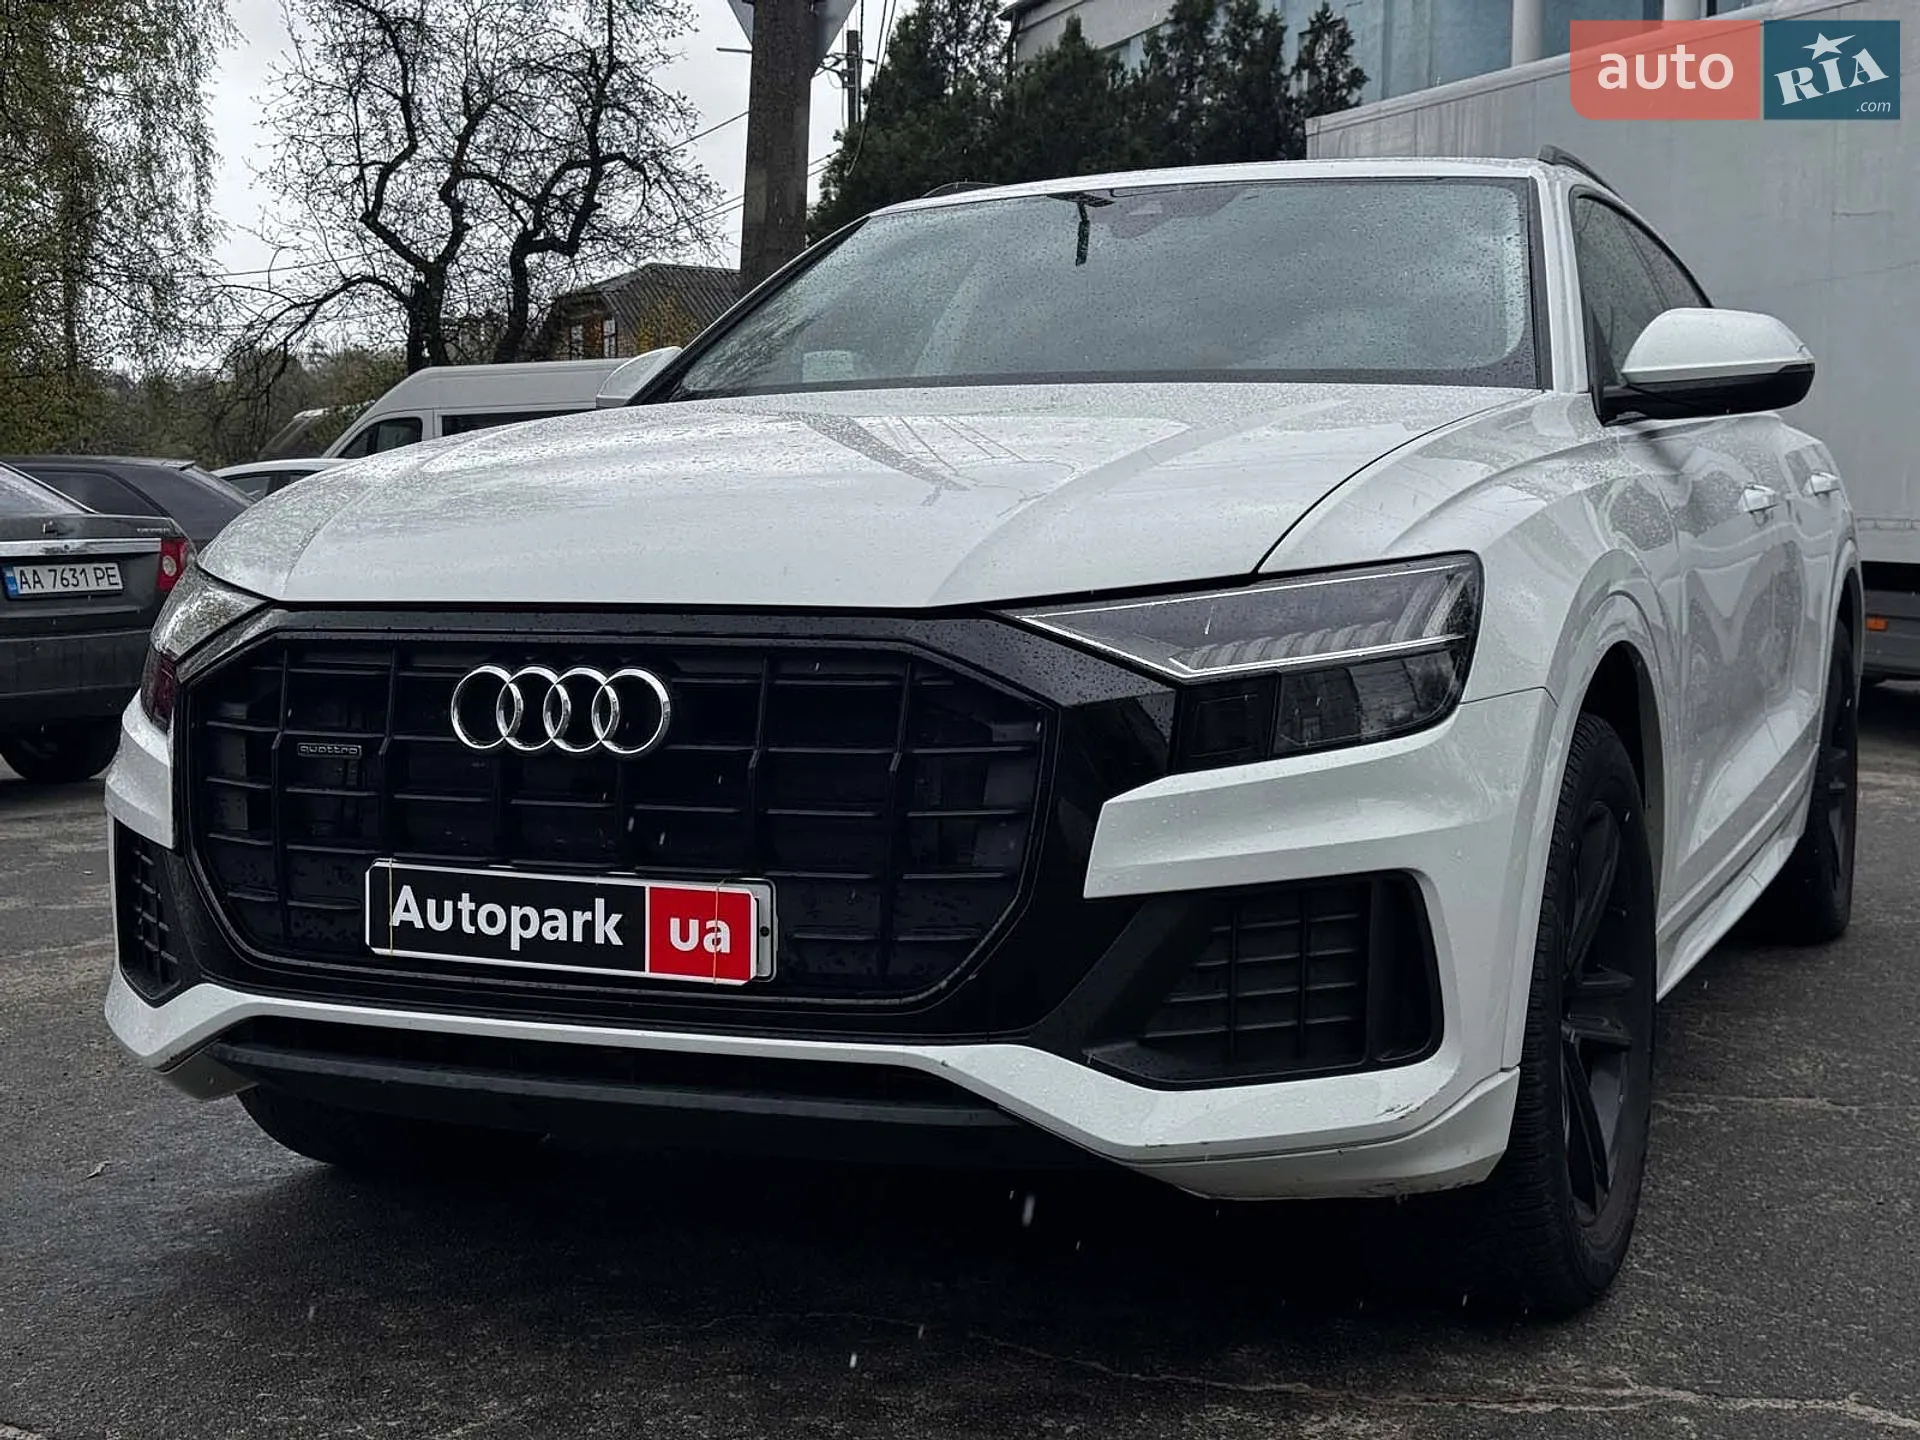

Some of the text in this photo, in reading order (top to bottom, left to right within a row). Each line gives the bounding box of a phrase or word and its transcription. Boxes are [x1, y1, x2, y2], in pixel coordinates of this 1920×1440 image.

[18, 565, 120, 590] AA 7631 PE
[391, 884, 732, 955] Autopark ua
